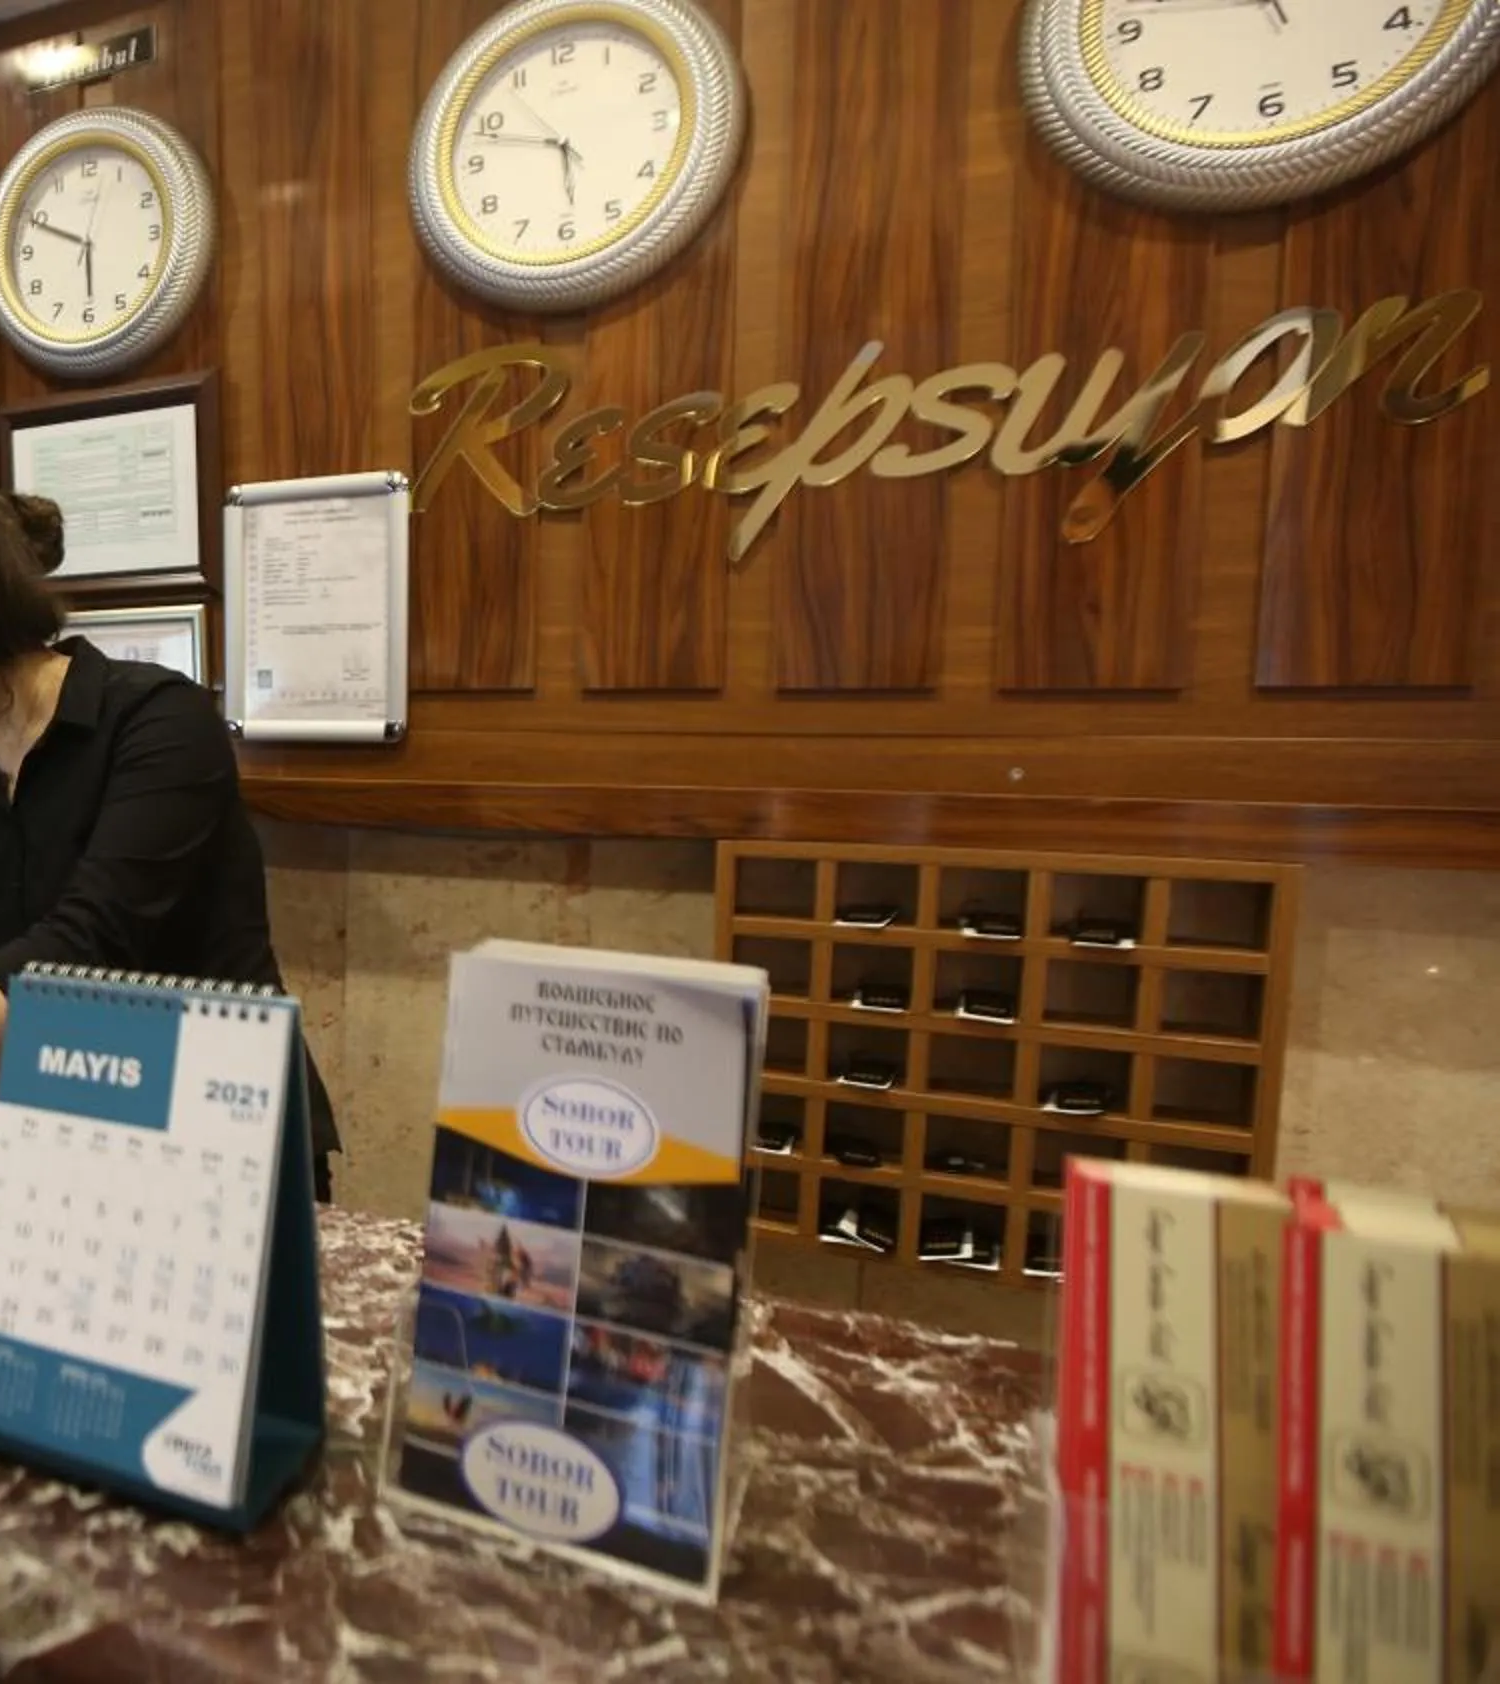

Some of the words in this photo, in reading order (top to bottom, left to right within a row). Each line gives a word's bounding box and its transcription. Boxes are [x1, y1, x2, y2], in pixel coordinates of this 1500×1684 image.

[1382, 6, 1413, 31] 4
[1117, 18, 1144, 45] 9
[550, 42, 576, 65] 12
[513, 68, 527, 89] 11
[638, 72, 657, 94] 2
[1138, 67, 1165, 93] 8
[1332, 60, 1358, 88] 5
[1188, 94, 1214, 121] 7
[1258, 91, 1285, 118] 6
[477, 111, 504, 134] 10
[651, 109, 668, 132] 3
[81, 160, 98, 178] 12
[468, 155, 485, 174] 9
[636, 159, 655, 179] 4
[140, 191, 153, 209] 2
[480, 194, 499, 215] 8
[605, 199, 621, 220] 5
[147, 223, 160, 241] 3
[513, 218, 530, 240] 7
[557, 220, 576, 241] 6
[21, 244, 33, 261] 9
[137, 264, 149, 279] 4
[30, 279, 42, 295] 8
[52, 302, 64, 319] 7
[115, 294, 126, 311] 5
[83, 307, 95, 323] 6
[39, 1043, 142, 1088] MAYIS
[205, 1079, 269, 1109] 2021
[549, 1128, 623, 1160] TOUR
[496, 1477, 579, 1527] TOUR
